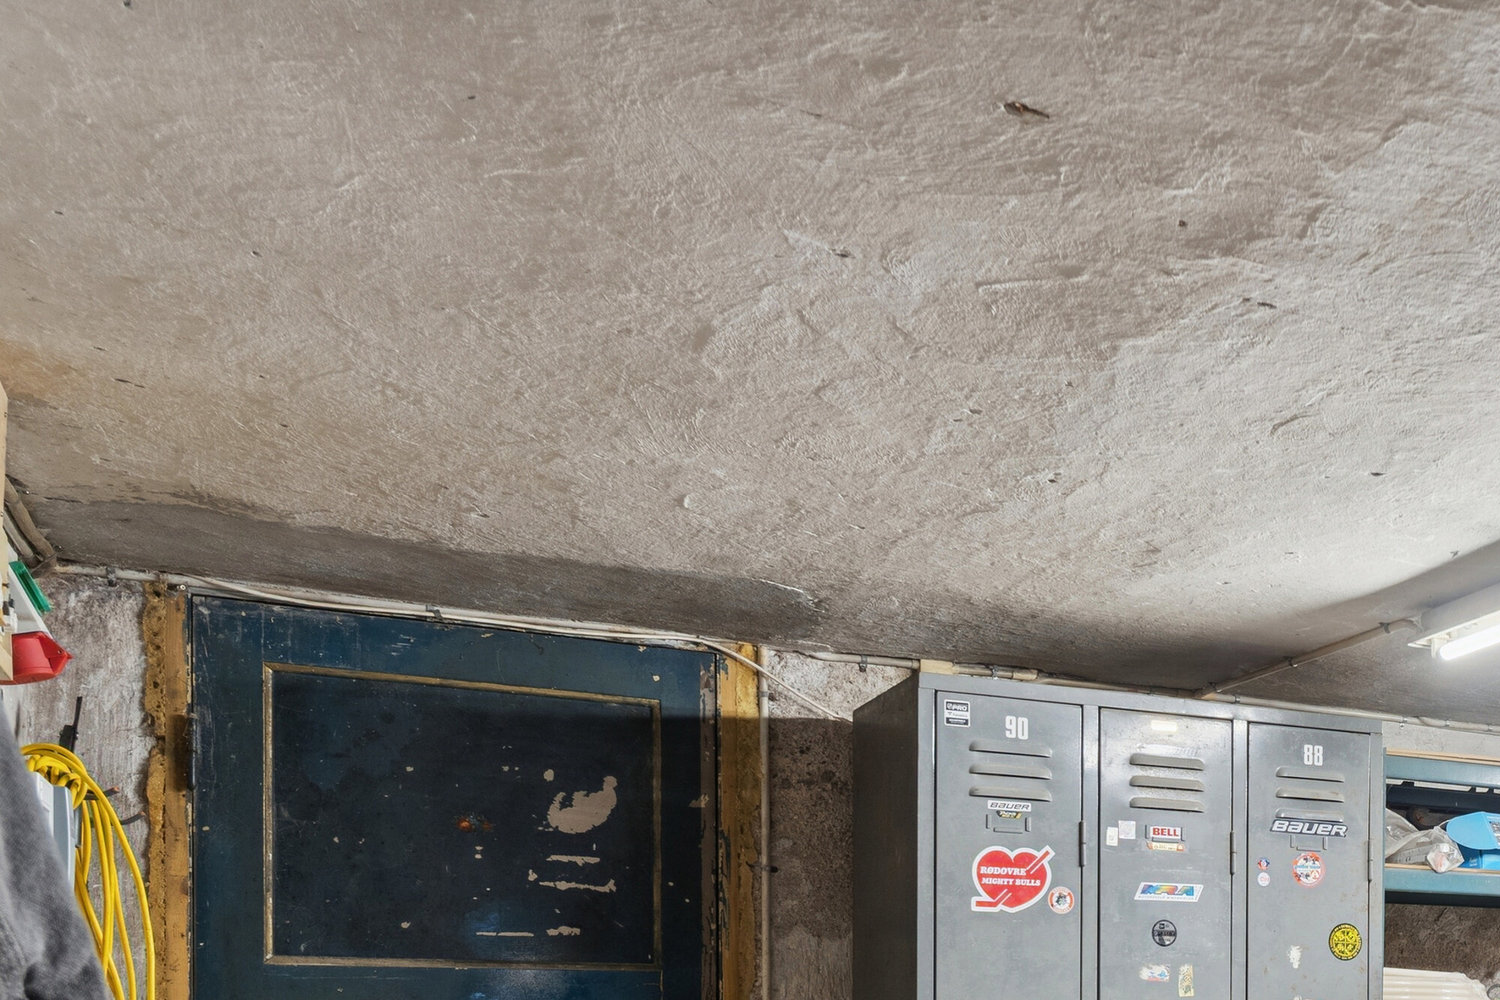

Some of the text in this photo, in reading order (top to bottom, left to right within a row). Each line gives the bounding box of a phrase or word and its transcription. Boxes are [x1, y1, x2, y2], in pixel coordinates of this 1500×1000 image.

[1005, 715, 1029, 740] 90
[1303, 744, 1324, 767] 88
[1152, 827, 1180, 837] BELL
[981, 877, 1041, 887] MIGHTY BULLS
